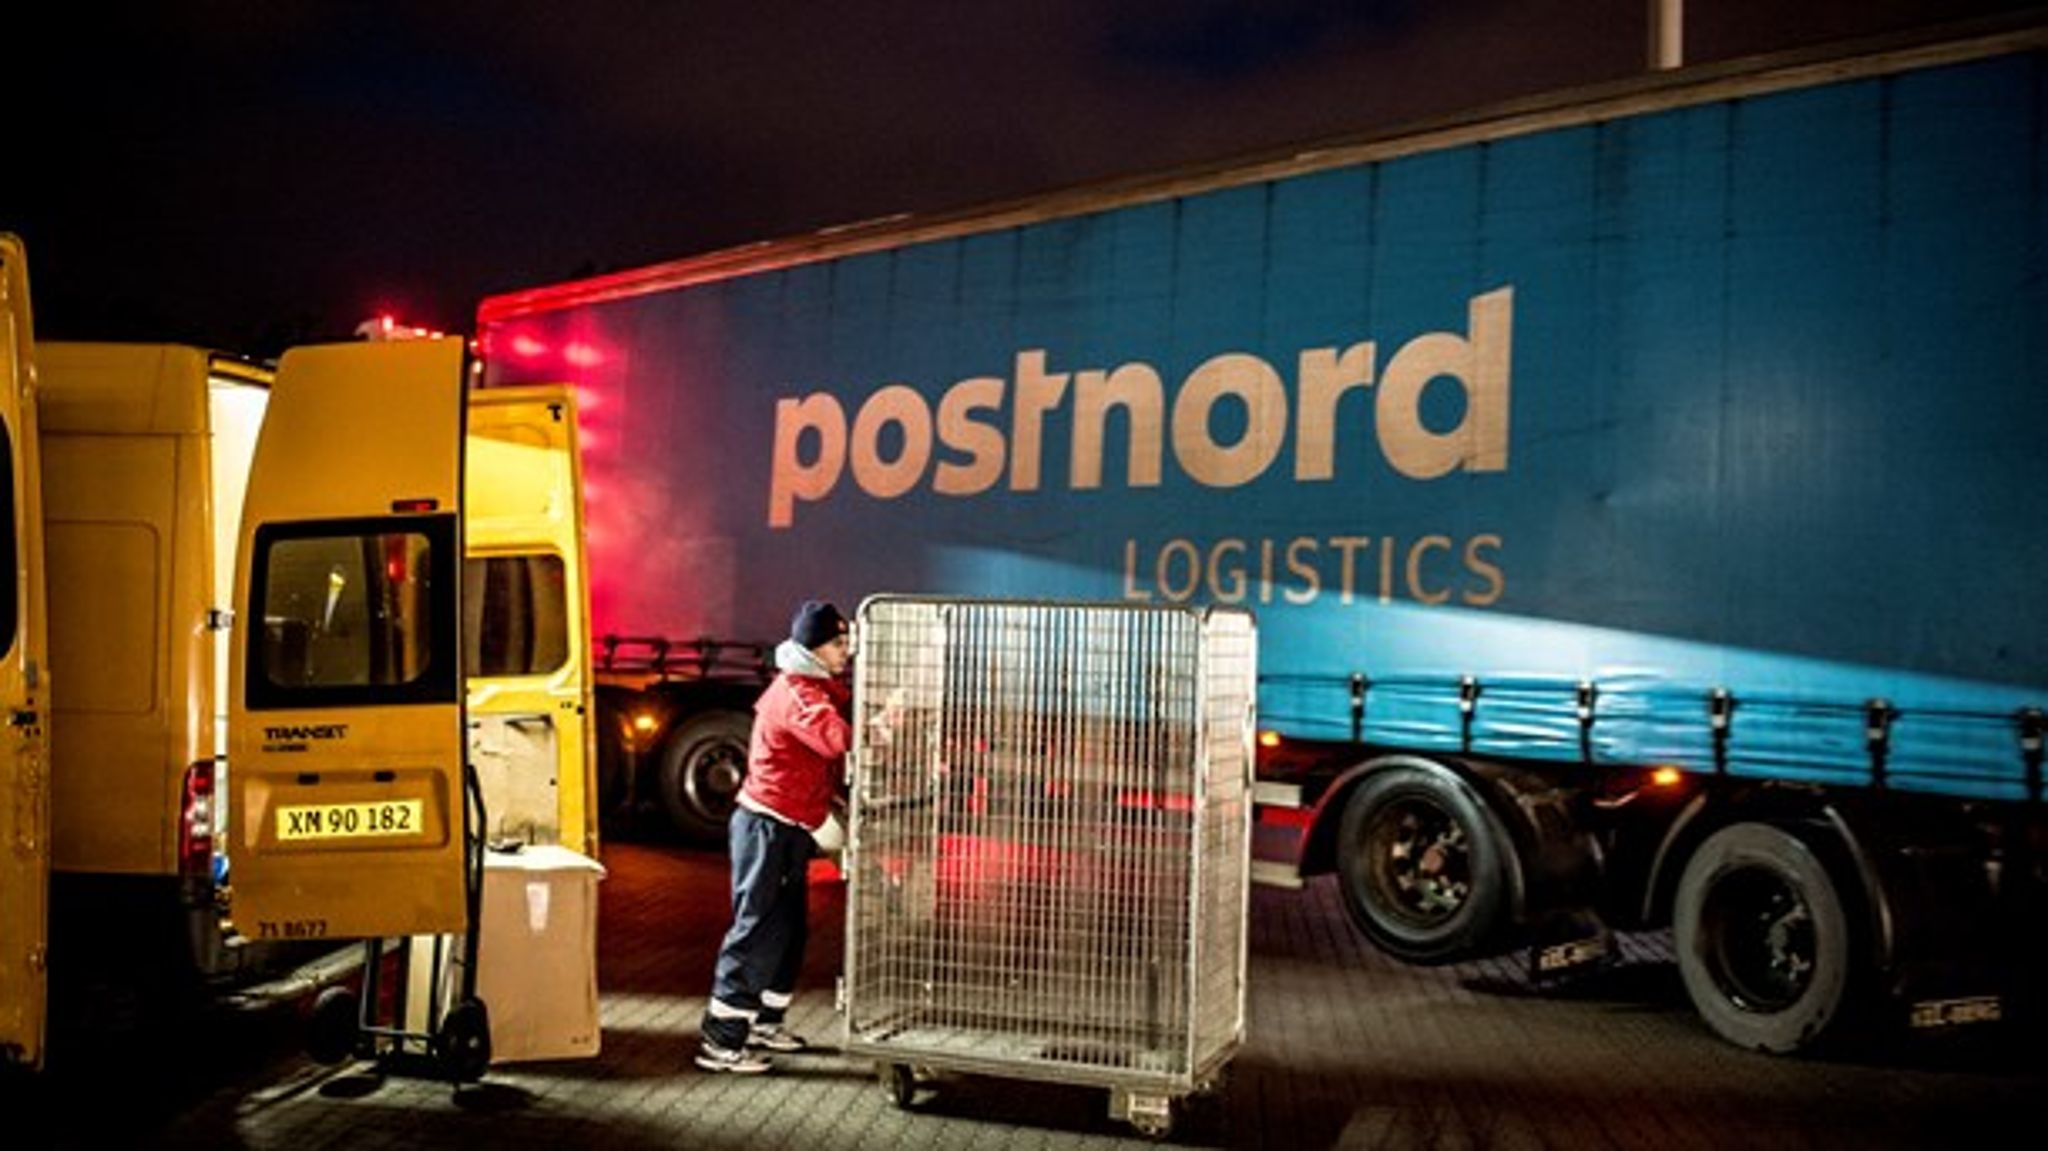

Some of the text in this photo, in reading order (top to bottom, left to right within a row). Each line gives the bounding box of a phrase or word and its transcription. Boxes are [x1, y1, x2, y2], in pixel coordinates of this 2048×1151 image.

[768, 286, 1512, 527] postnord
[1125, 535, 1506, 605] LOGISTICS
[288, 805, 411, 835] XM 90 182
